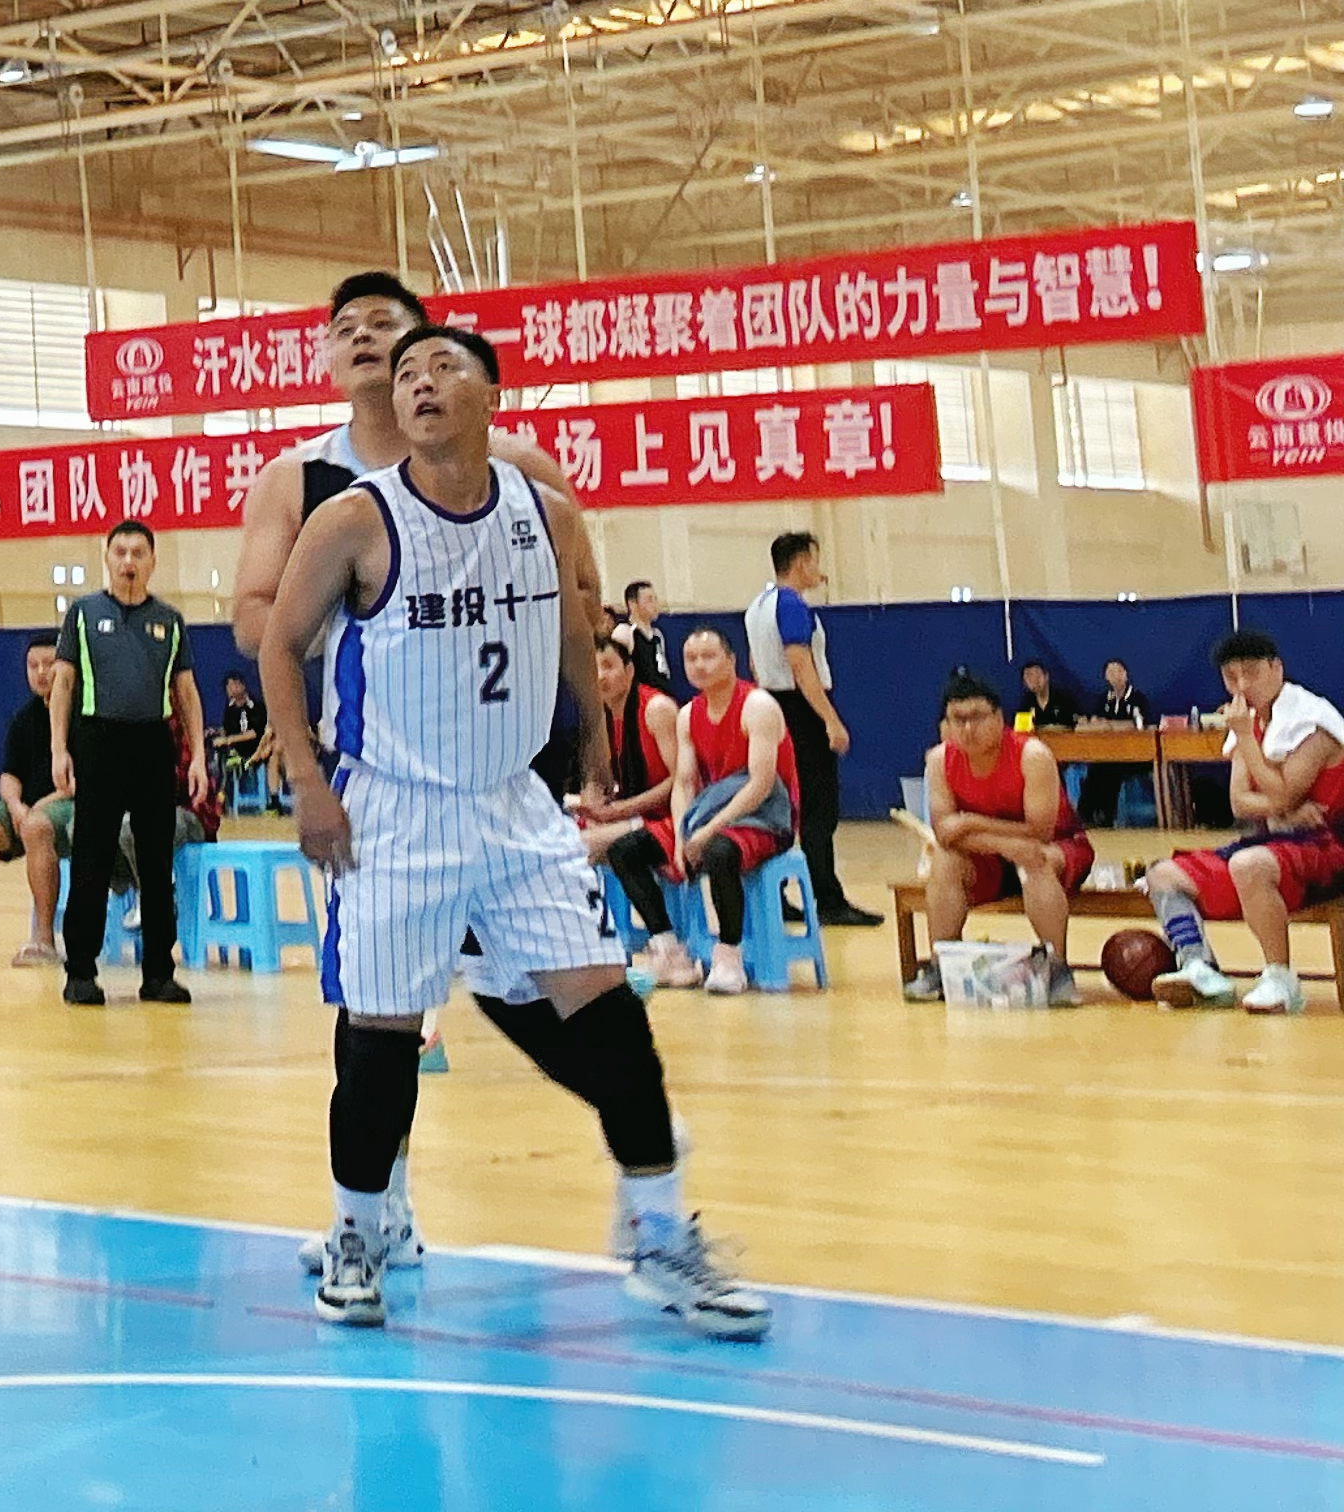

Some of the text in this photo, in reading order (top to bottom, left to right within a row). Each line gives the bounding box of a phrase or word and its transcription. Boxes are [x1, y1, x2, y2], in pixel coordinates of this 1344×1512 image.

[405, 583, 559, 630] 建投十一
[479, 641, 509, 704] 2
